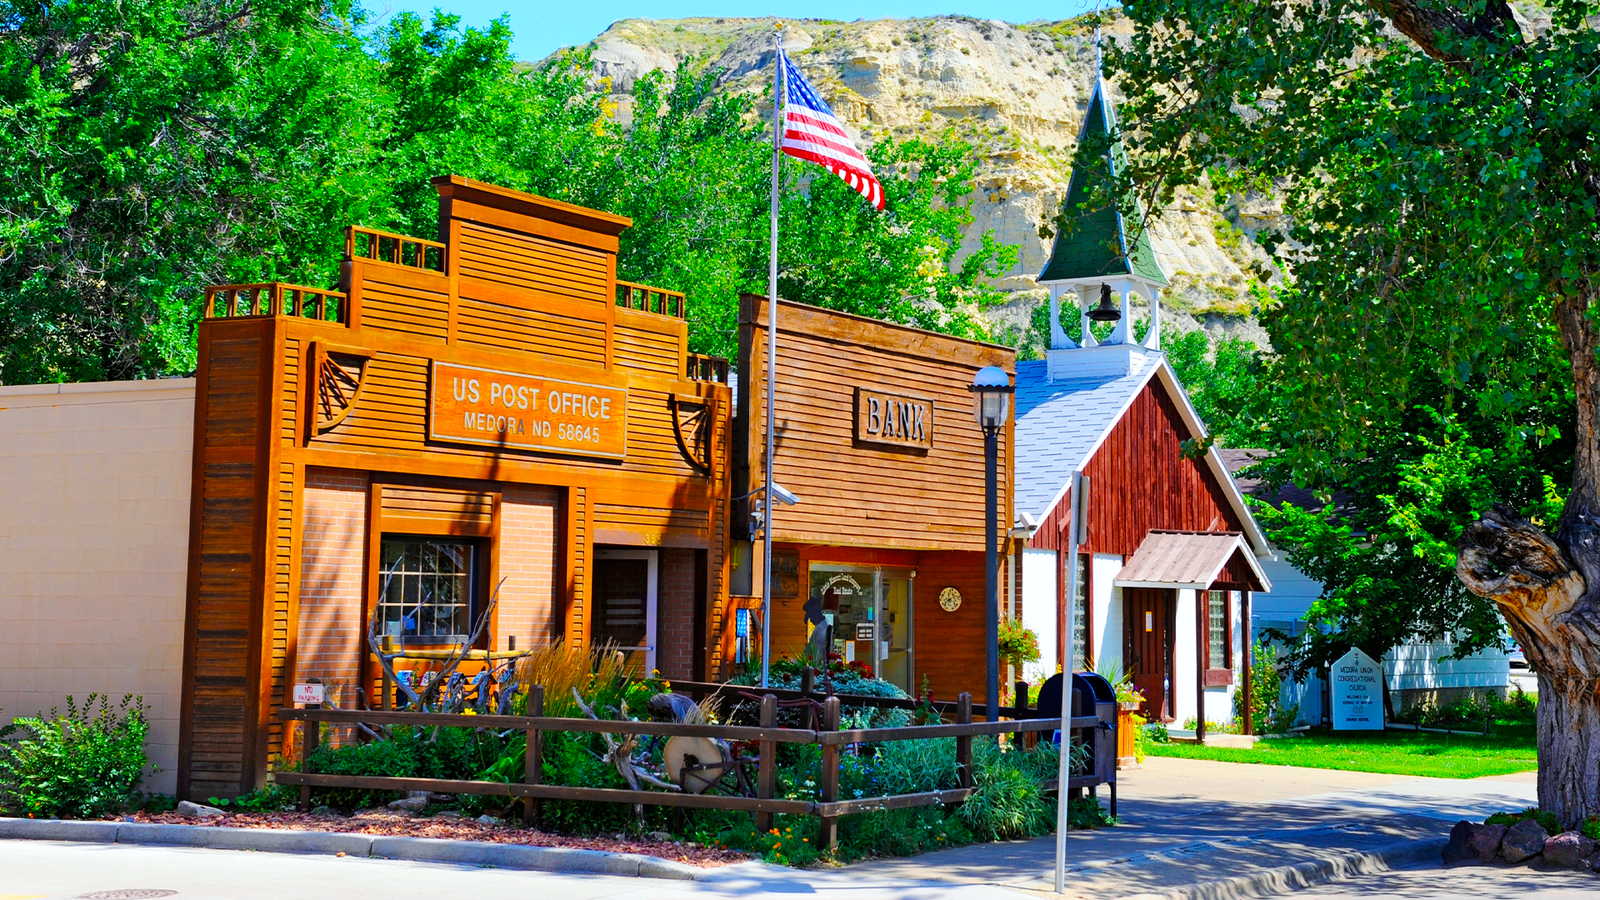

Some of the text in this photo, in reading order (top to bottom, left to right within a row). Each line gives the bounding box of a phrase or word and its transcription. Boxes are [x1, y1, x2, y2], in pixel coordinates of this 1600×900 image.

[453, 377, 611, 420] US POST OFFICE
[868, 397, 926, 440] BANK
[464, 411, 600, 444] MEDORA ND 58645
